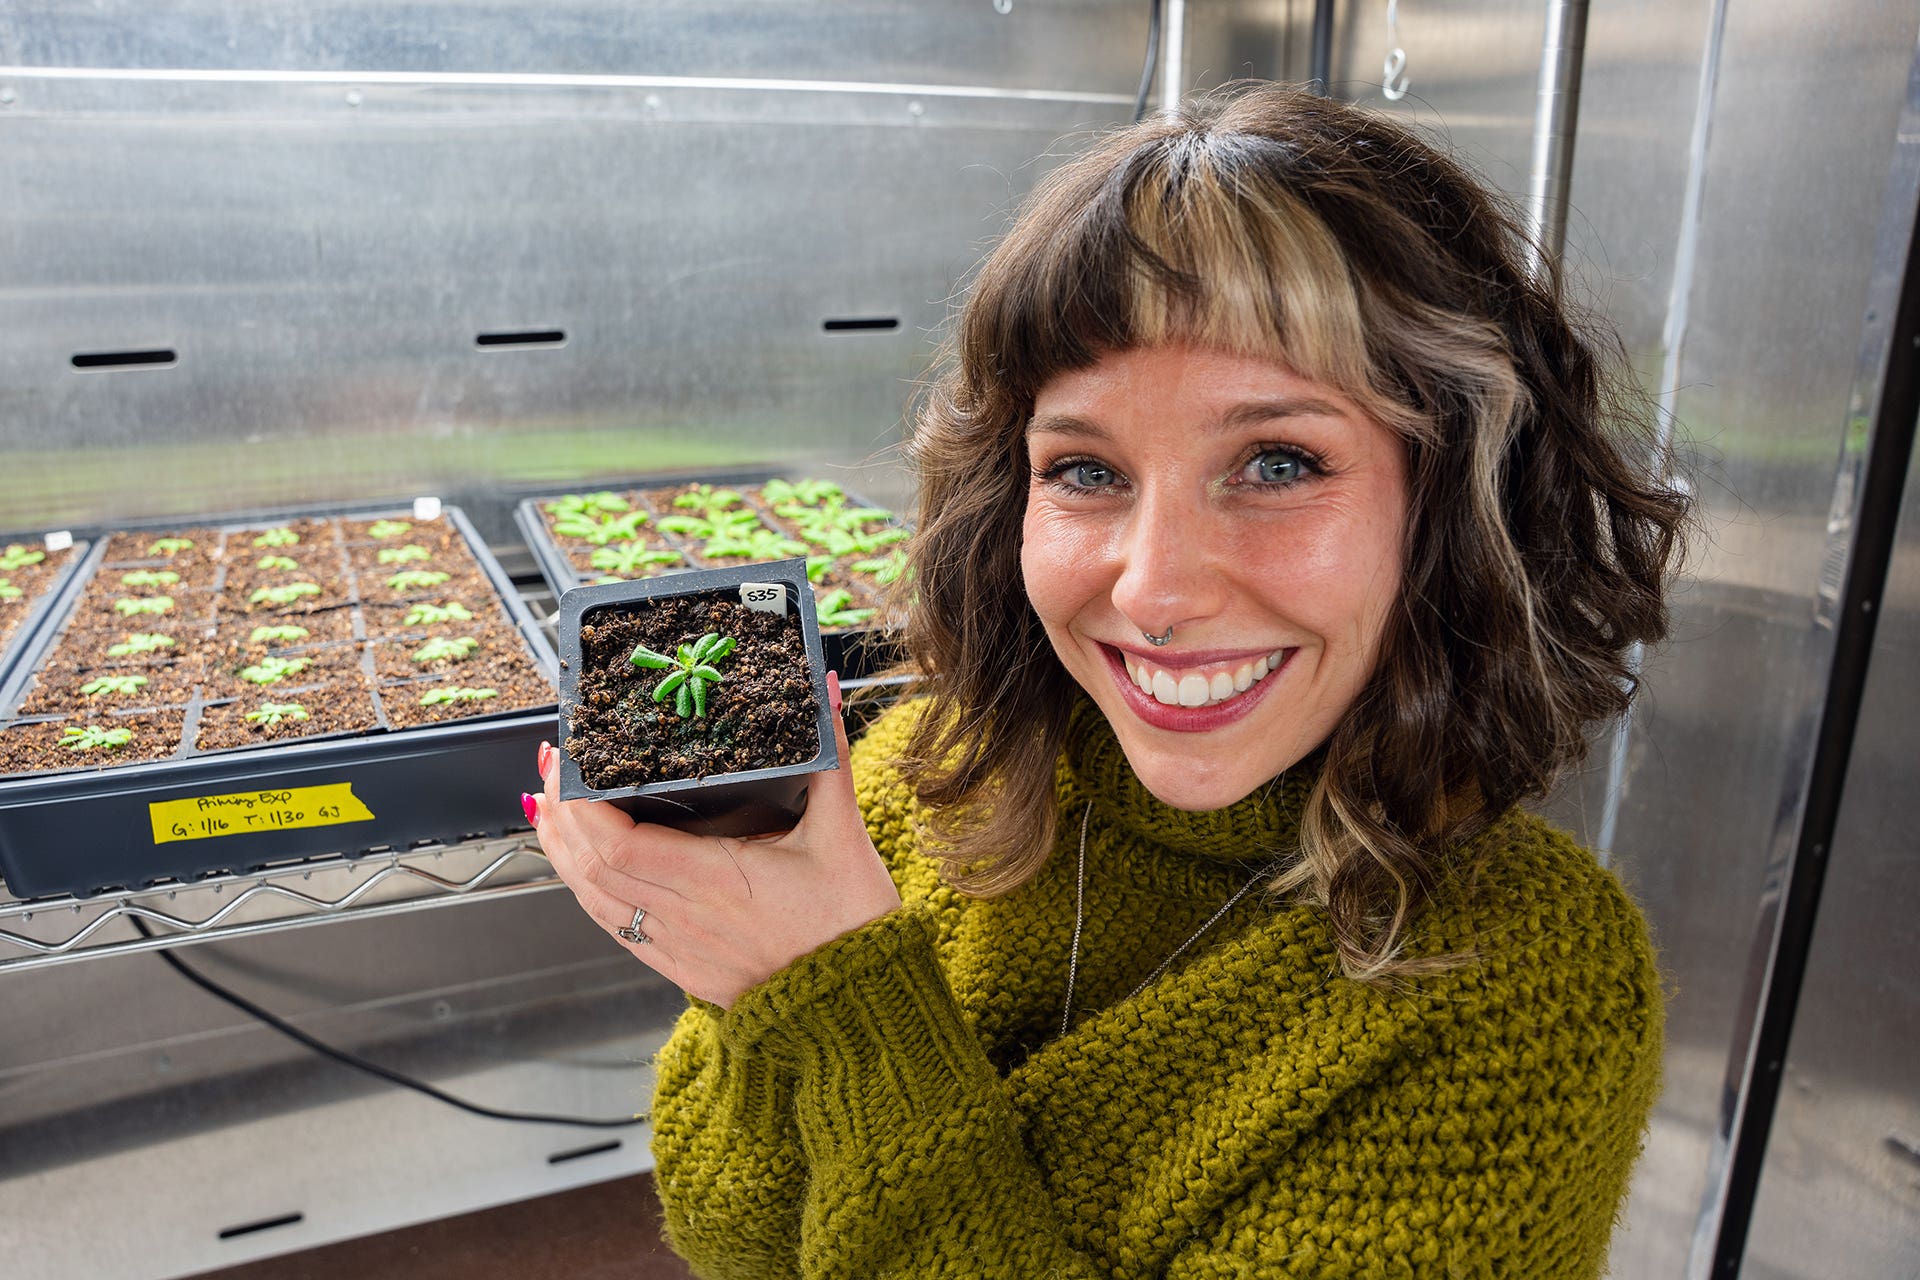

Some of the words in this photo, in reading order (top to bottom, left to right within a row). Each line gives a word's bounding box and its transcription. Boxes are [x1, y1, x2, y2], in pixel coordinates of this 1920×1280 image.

[747, 588, 778, 602] S35
[172, 823, 194, 837] G:
[201, 818, 229, 835] 1/16
[244, 814, 265, 826] T:
[270, 810, 304, 827] 1/30
